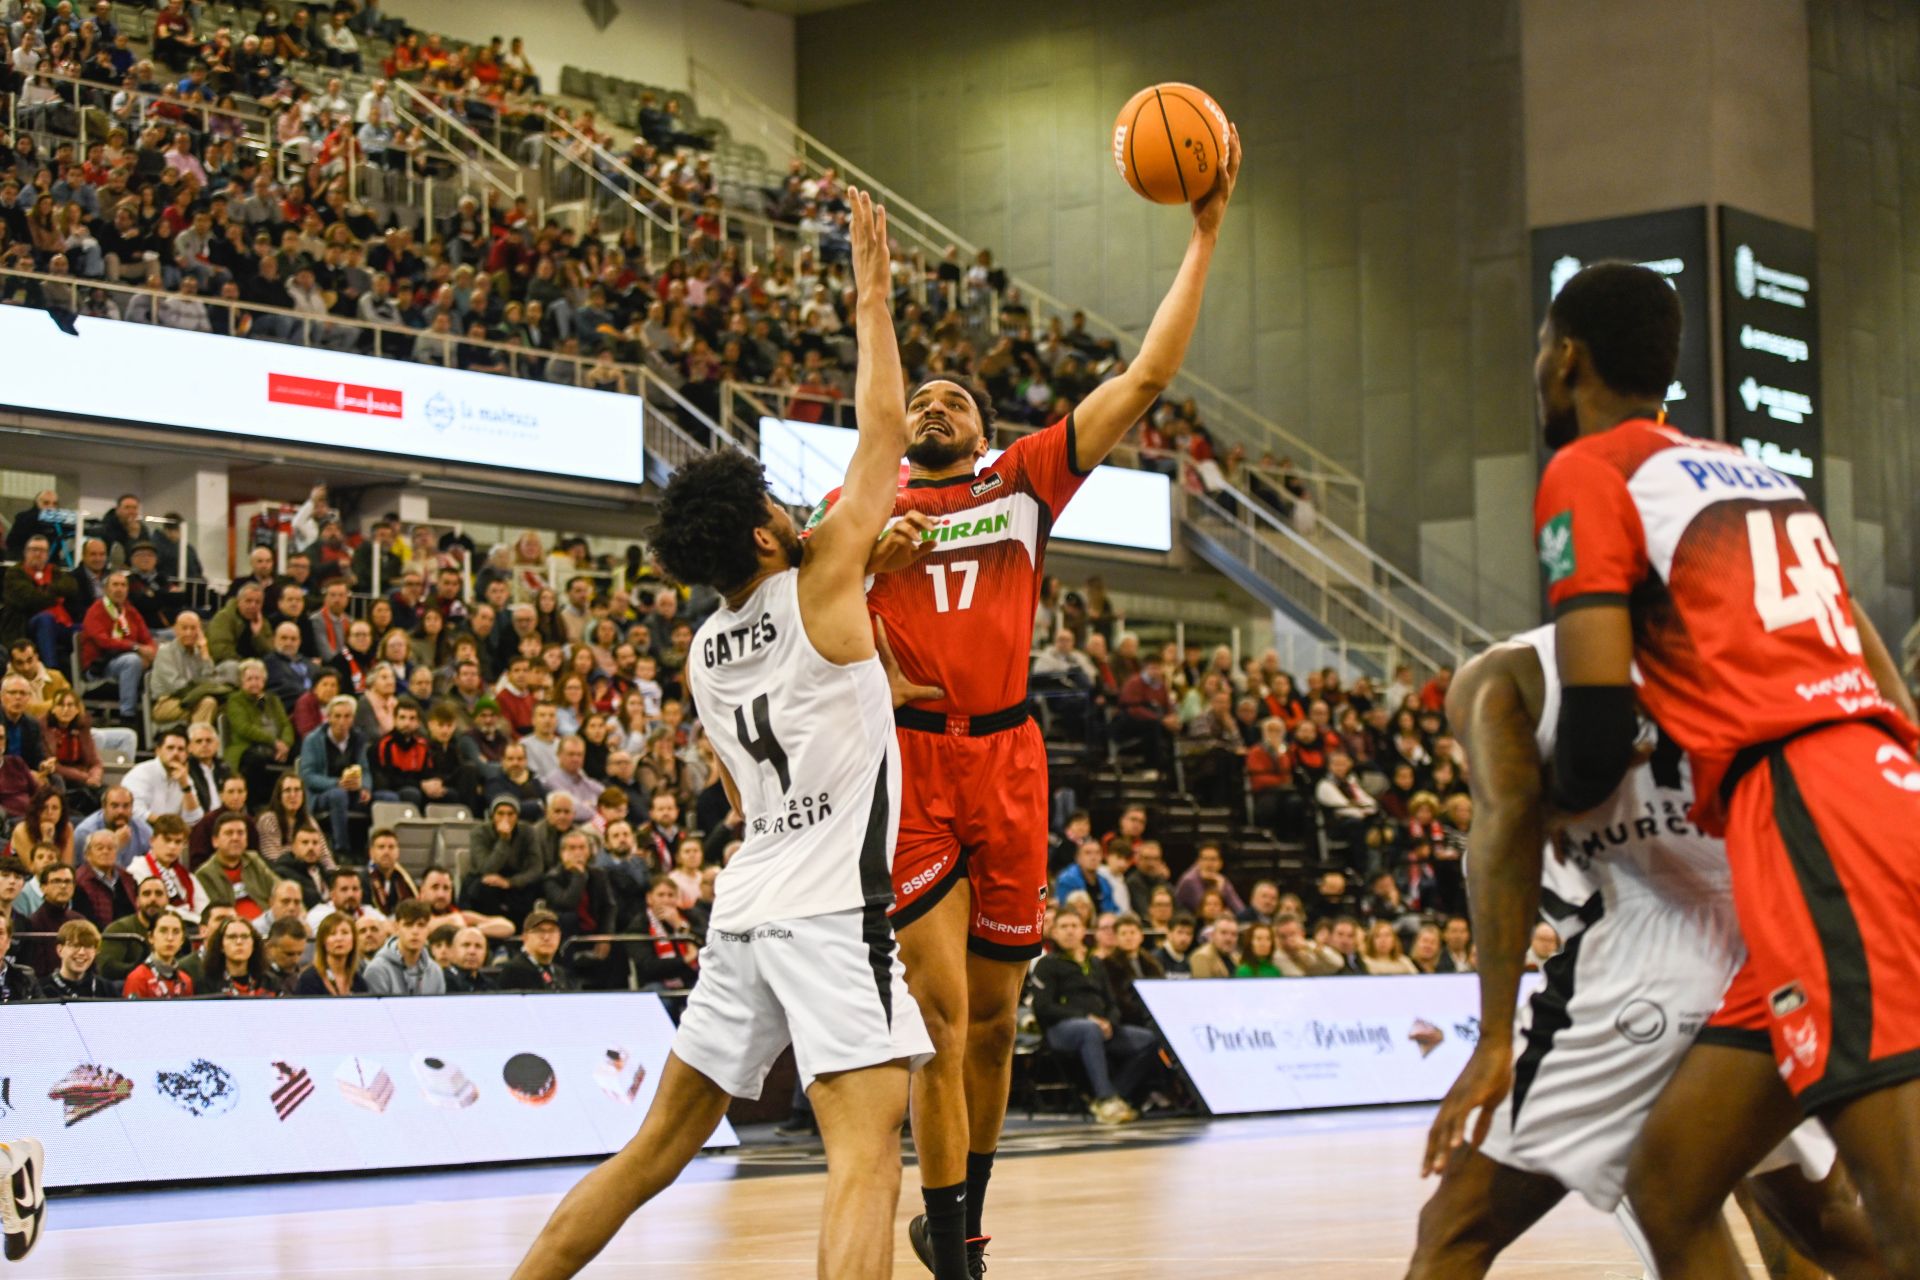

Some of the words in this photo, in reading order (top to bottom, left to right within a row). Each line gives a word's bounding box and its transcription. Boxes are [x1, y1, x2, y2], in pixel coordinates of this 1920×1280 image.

[925, 559, 980, 613] 17
[703, 611, 778, 669] GATES
[733, 692, 792, 796] 4
[1582, 815, 1704, 857] MURC
[981, 916, 1033, 935] BERNER
